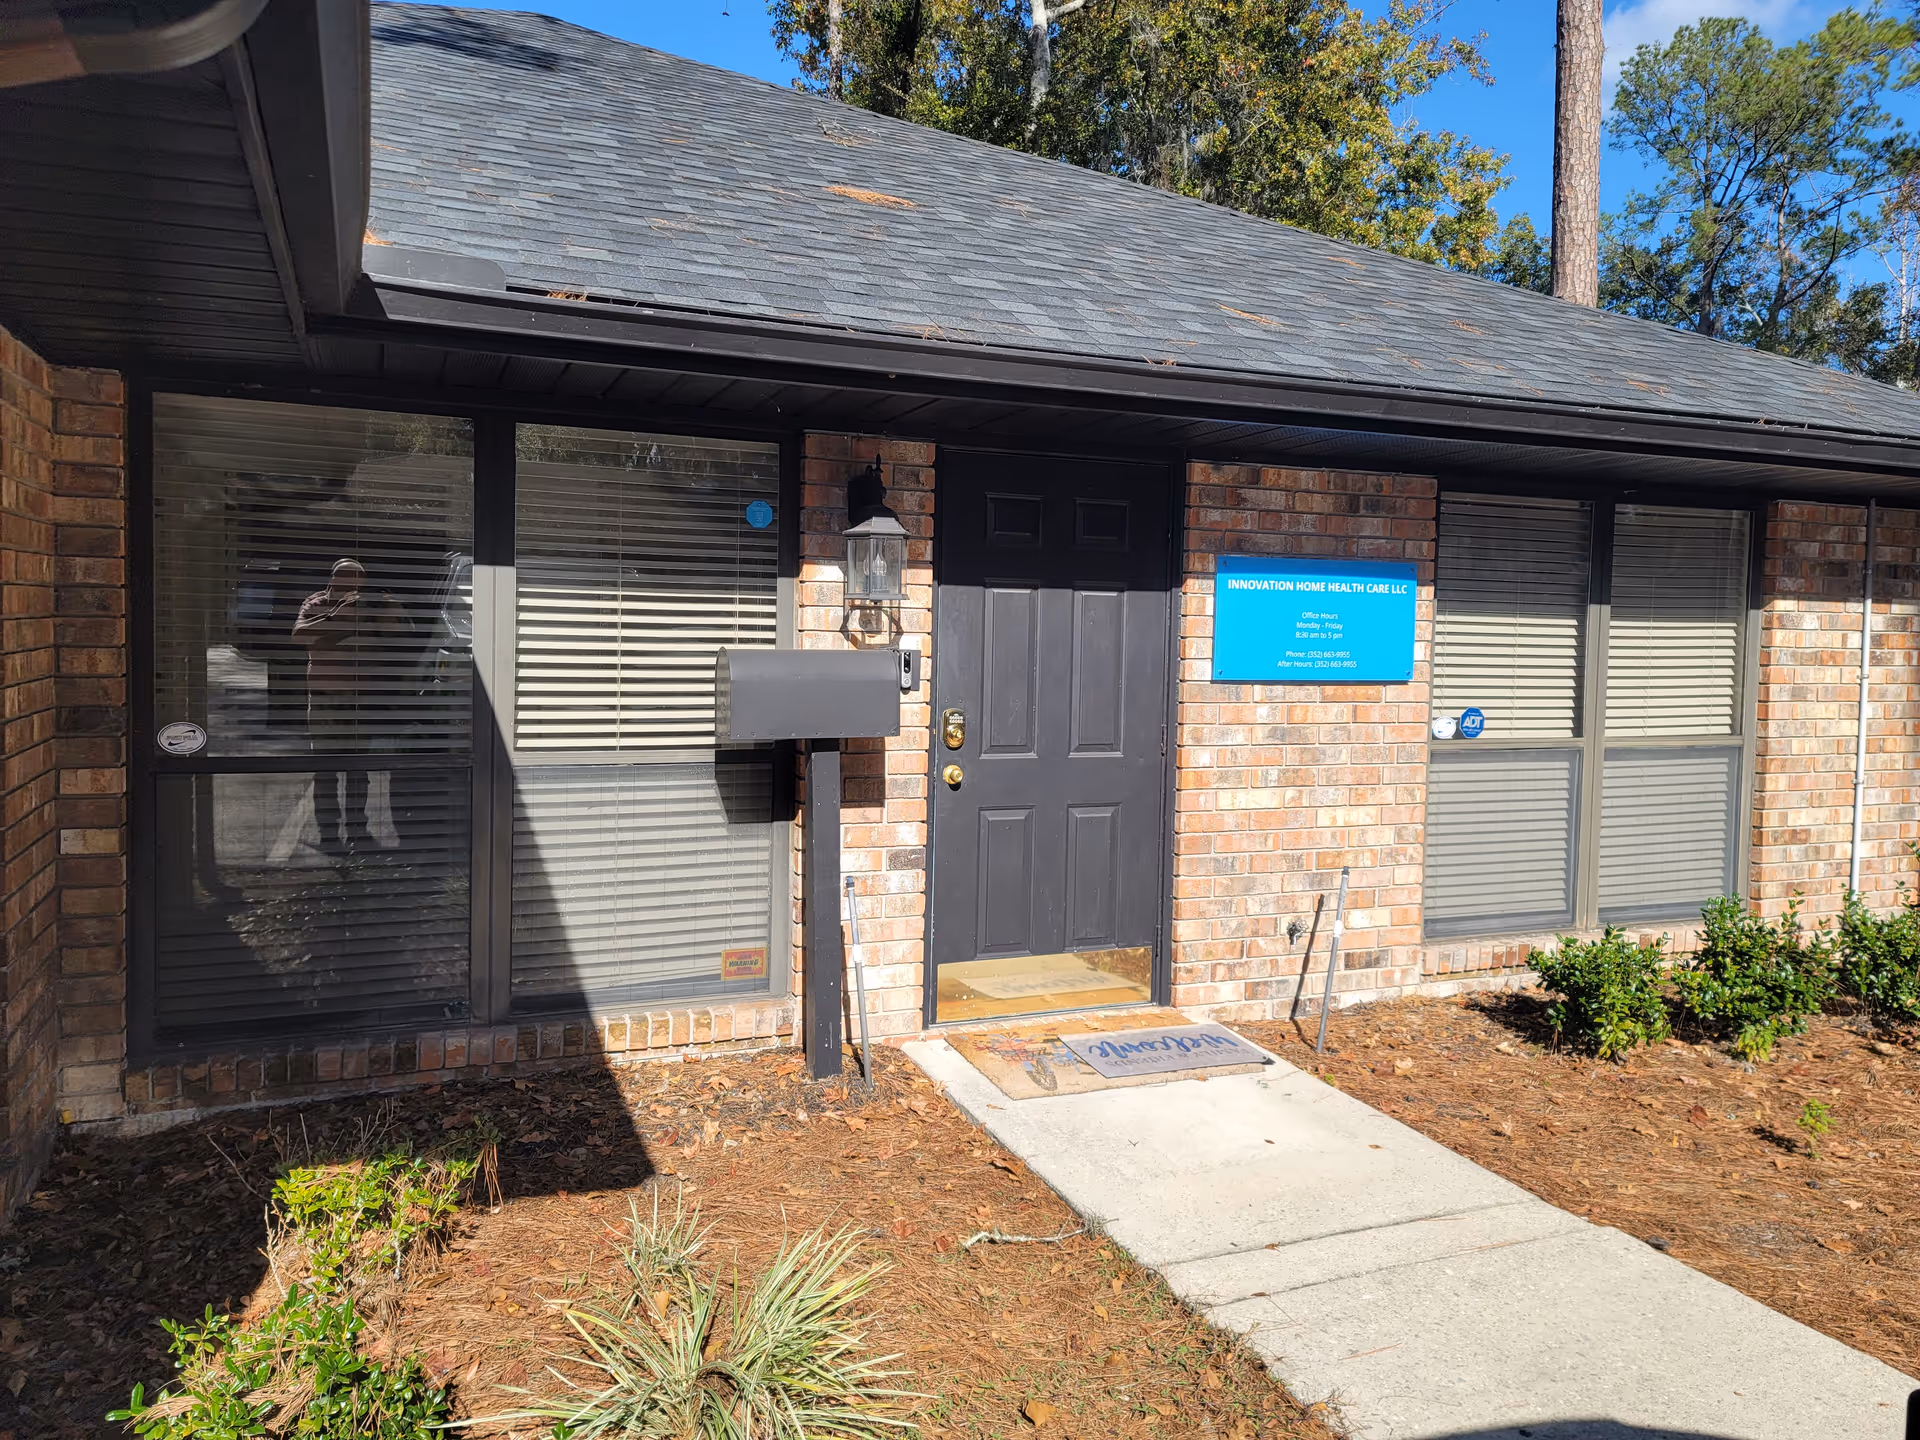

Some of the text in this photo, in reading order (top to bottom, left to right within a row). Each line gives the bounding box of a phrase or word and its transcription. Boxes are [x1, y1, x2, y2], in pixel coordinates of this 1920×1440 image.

[1228, 579, 1408, 594] INNOVATION HOME HEALTH CARE LLC
[1301, 611, 1338, 620] Office Hours
[1296, 621, 1320, 630] Monday
[1325, 622, 1343, 631] Friday
[1286, 650, 1307, 658] Phone:
[1307, 651, 1322, 659] (352)
[1315, 660, 1329, 668] (352)
[1462, 716, 1483, 729] ADT
[729, 958, 759, 968] WARNING
